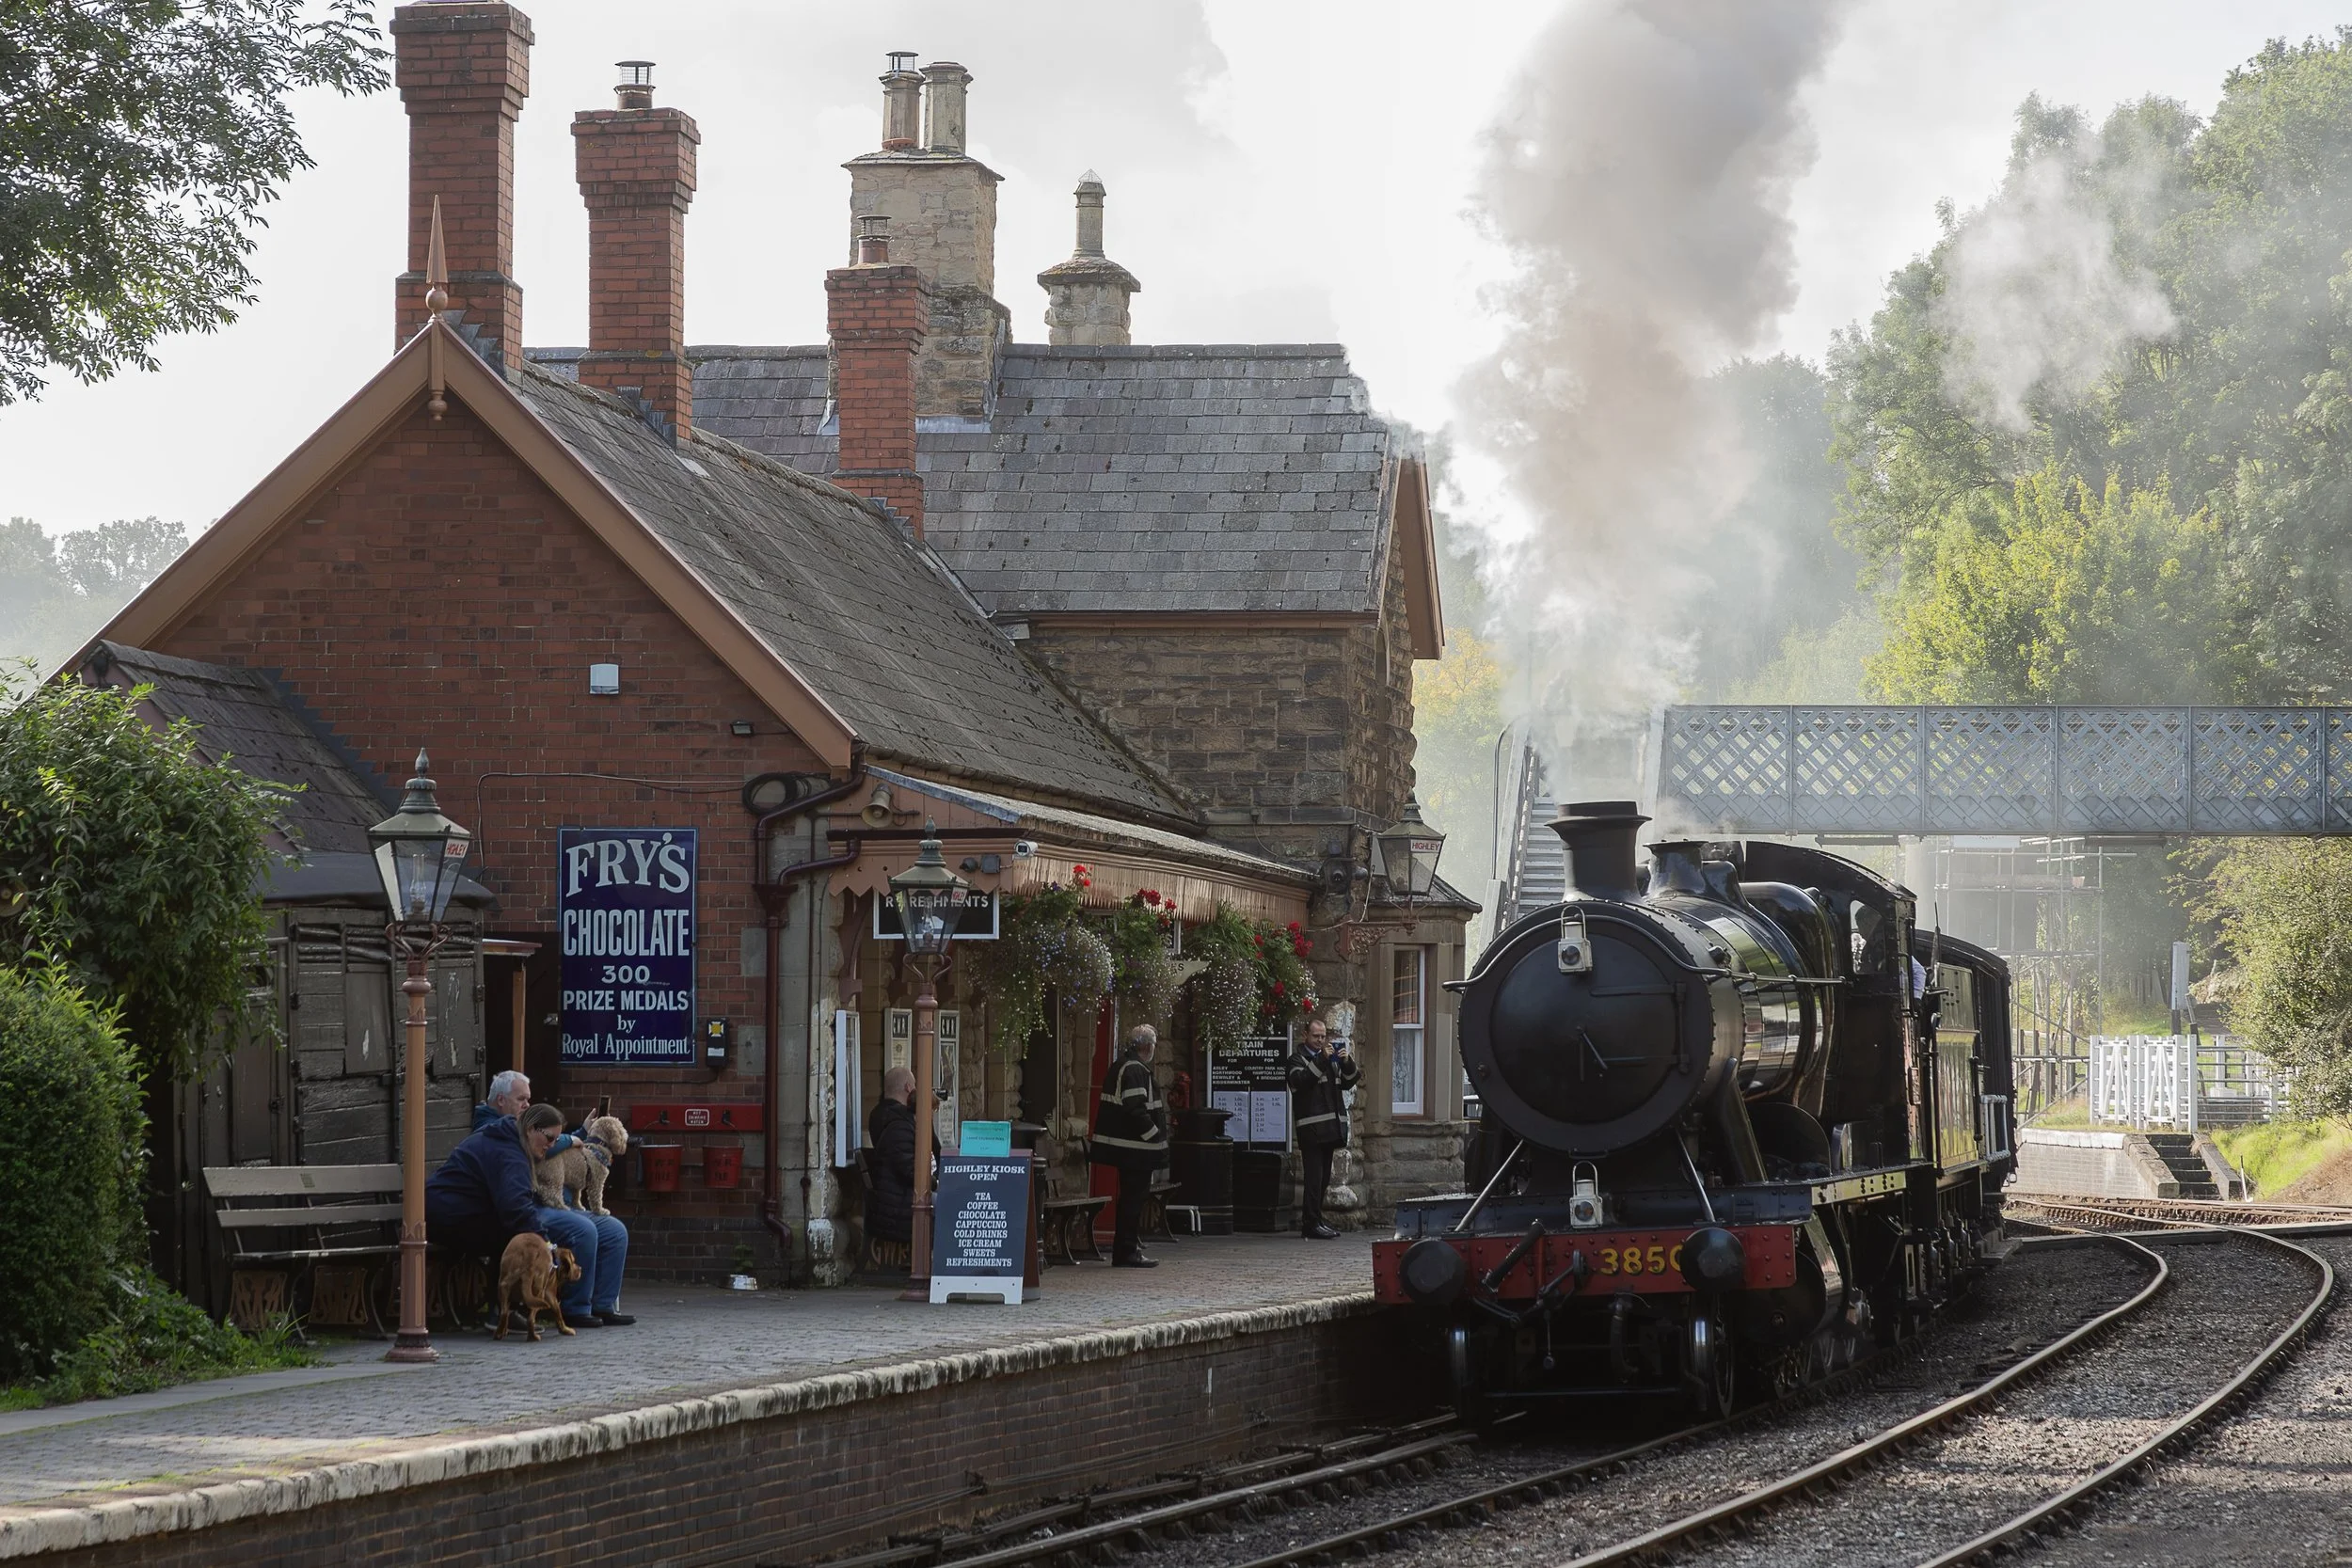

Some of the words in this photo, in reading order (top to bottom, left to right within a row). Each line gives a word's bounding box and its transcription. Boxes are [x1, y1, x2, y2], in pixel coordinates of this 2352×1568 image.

[1412, 842, 1440, 851] HIGHLEY
[566, 832, 690, 897] FRY'S
[564, 909, 690, 957] CHOCOLATE
[601, 965, 650, 984] 300
[564, 990, 615, 1011] PRIZE
[621, 990, 689, 1011] MEDALS
[617, 1015, 636, 1032] by
[562, 1033, 599, 1058] Royal
[604, 1033, 690, 1061] Appointment
[944, 1165, 989, 1174] HIGHLEY
[992, 1165, 1025, 1174] KIOSK
[975, 1192, 991, 1201] TEA
[958, 1211, 1006, 1220] CHOCOLATE
[955, 1220, 1007, 1229] CAPPUCCINO
[954, 1230, 975, 1238] COLD
[976, 1230, 1007, 1238] DRINKS
[958, 1239, 972, 1248] ICE
[973, 1239, 1002, 1248] CREAM
[963, 1248, 996, 1257] SWEETS
[946, 1258, 1012, 1267] REFRESHMENTS
